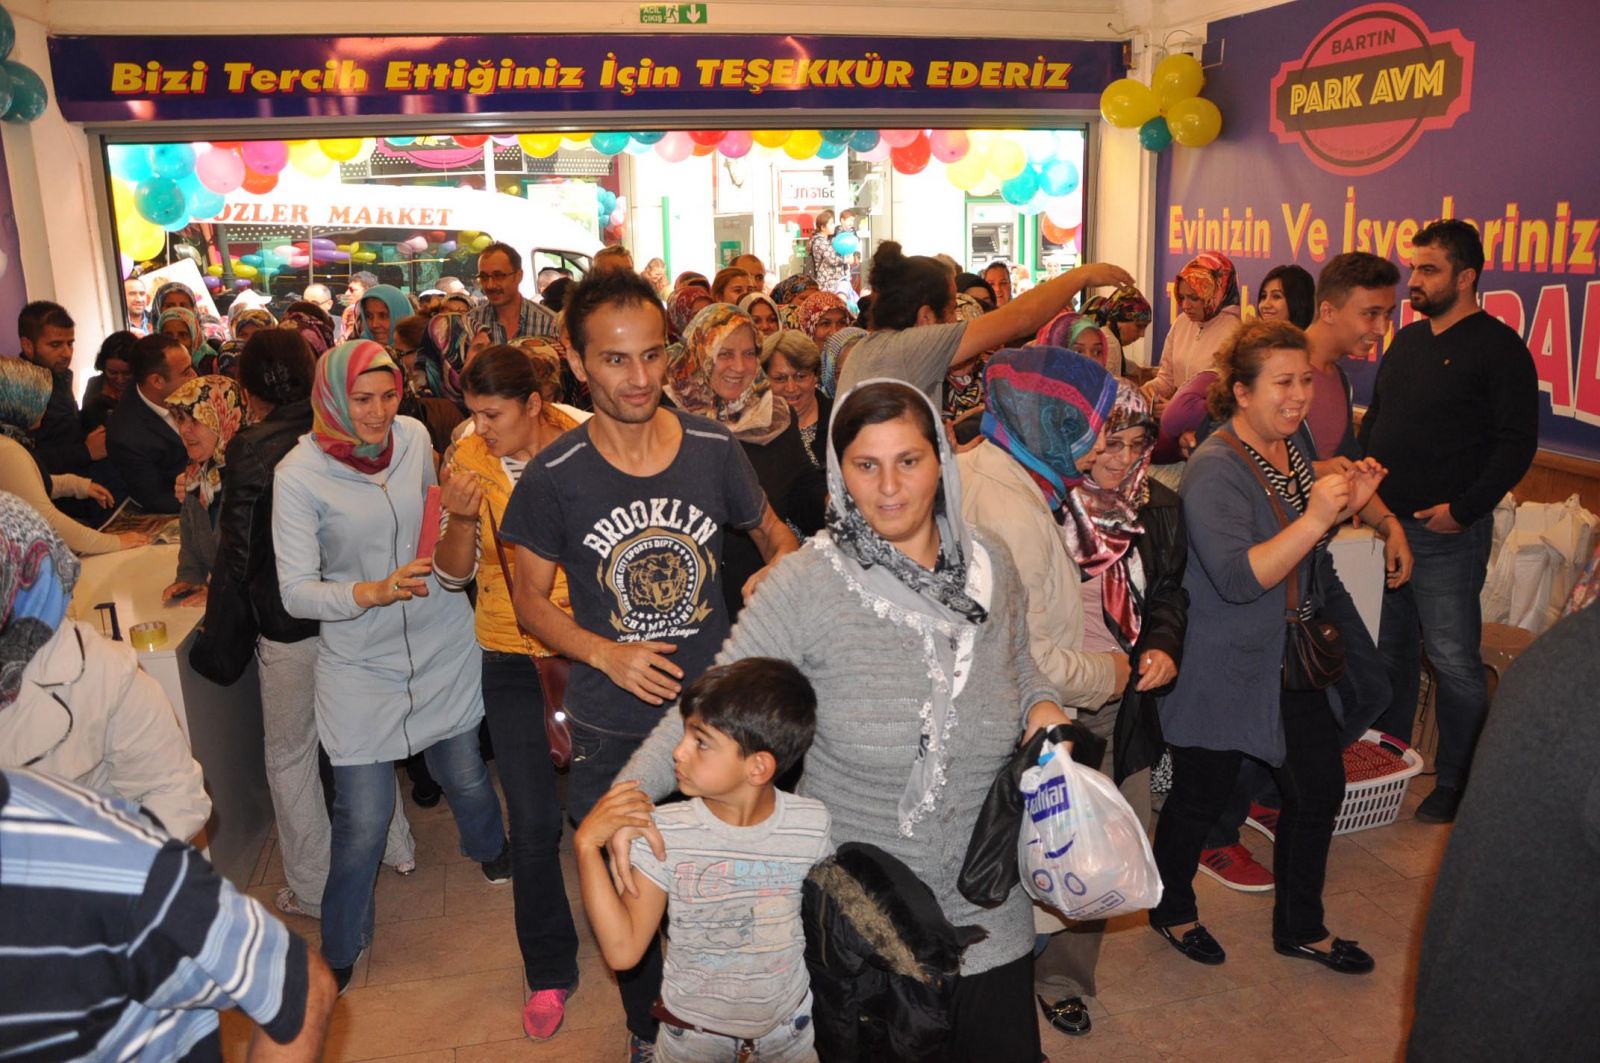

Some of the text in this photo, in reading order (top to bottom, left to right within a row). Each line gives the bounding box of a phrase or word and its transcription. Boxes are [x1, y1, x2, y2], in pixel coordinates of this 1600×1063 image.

[1331, 27, 1396, 55] BARTIN
[111, 52, 1072, 95] Bizi Tercih Ettiğiniz İçin TEŞEKKÜR EDERİZ
[1290, 59, 1445, 115] PARK AVM
[328, 205, 453, 226] MARKET
[1168, 204, 1272, 259] Evinizin
[1281, 202, 1330, 263] Ve
[583, 498, 717, 559] BROOKLYN
[624, 541, 653, 561] SPORTS
[622, 604, 694, 631] CHAMPIONS
